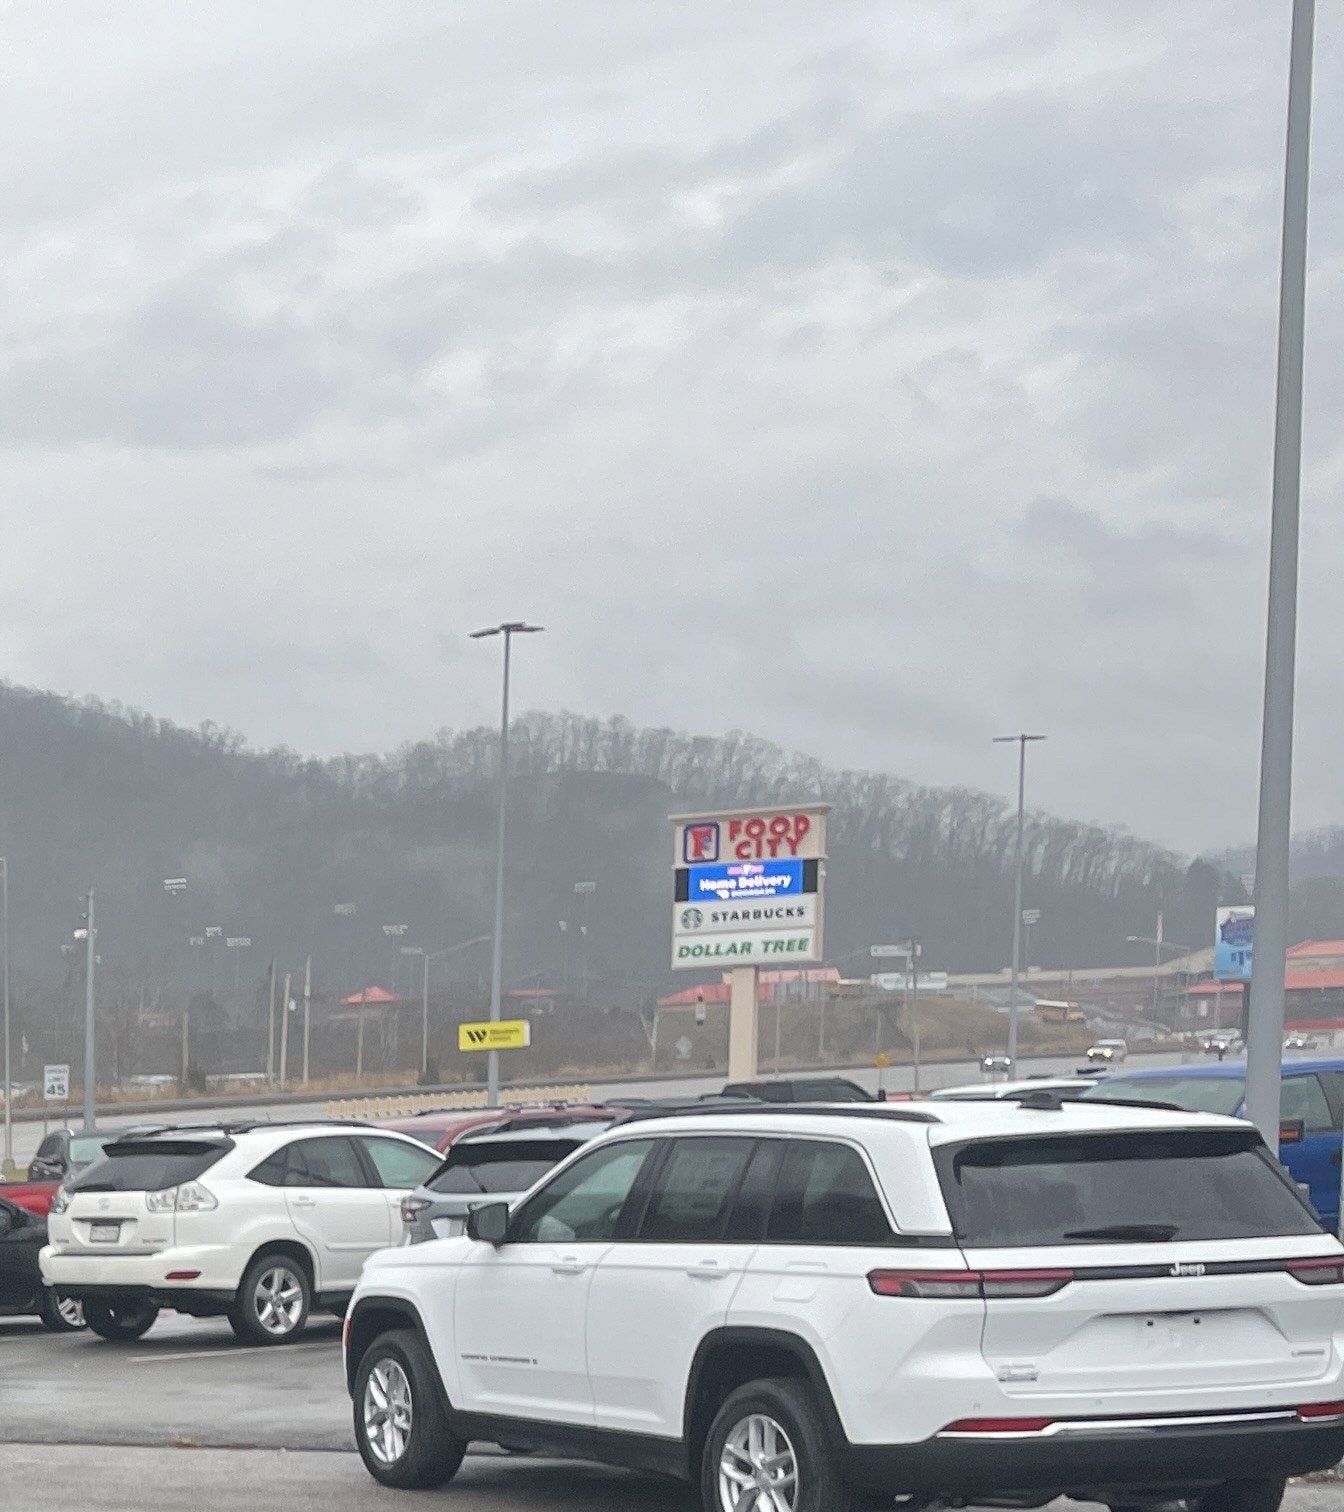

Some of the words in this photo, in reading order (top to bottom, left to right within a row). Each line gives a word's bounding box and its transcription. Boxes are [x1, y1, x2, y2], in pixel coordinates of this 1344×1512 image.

[728, 814, 810, 842] FOOD
[735, 835, 805, 860] CITY
[699, 878, 736, 892] Home
[738, 874, 792, 889] Delivery
[711, 906, 805, 922] STARBUCKS
[678, 940, 753, 959] DOLLAR
[762, 937, 810, 954] TREE
[46, 1083, 66, 1096] 45
[1169, 1261, 1205, 1277] Jeep
